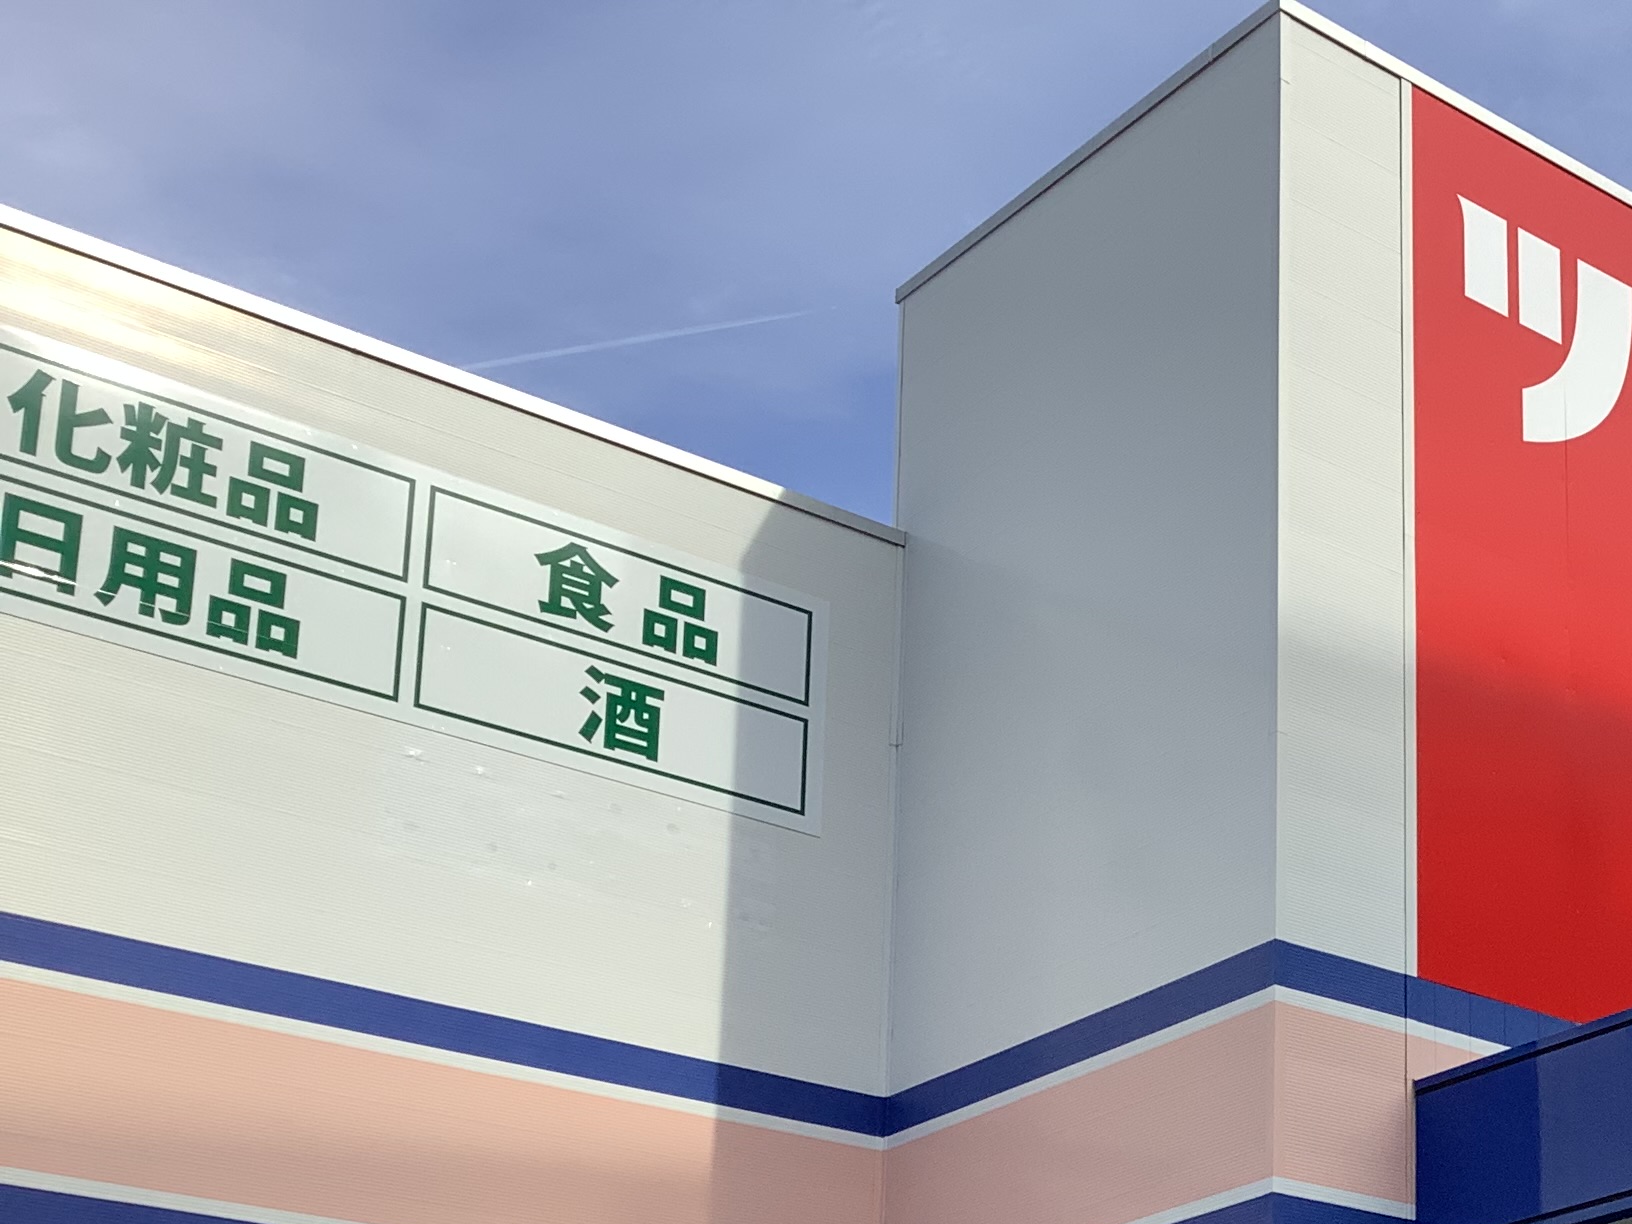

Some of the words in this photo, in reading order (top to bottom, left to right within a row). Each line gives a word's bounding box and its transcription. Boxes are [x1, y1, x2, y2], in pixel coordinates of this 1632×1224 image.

[7, 368, 319, 542] 化粧品
[0, 493, 300, 660] 日用品
[534, 541, 719, 667] 食品
[577, 665, 665, 762] 酒
